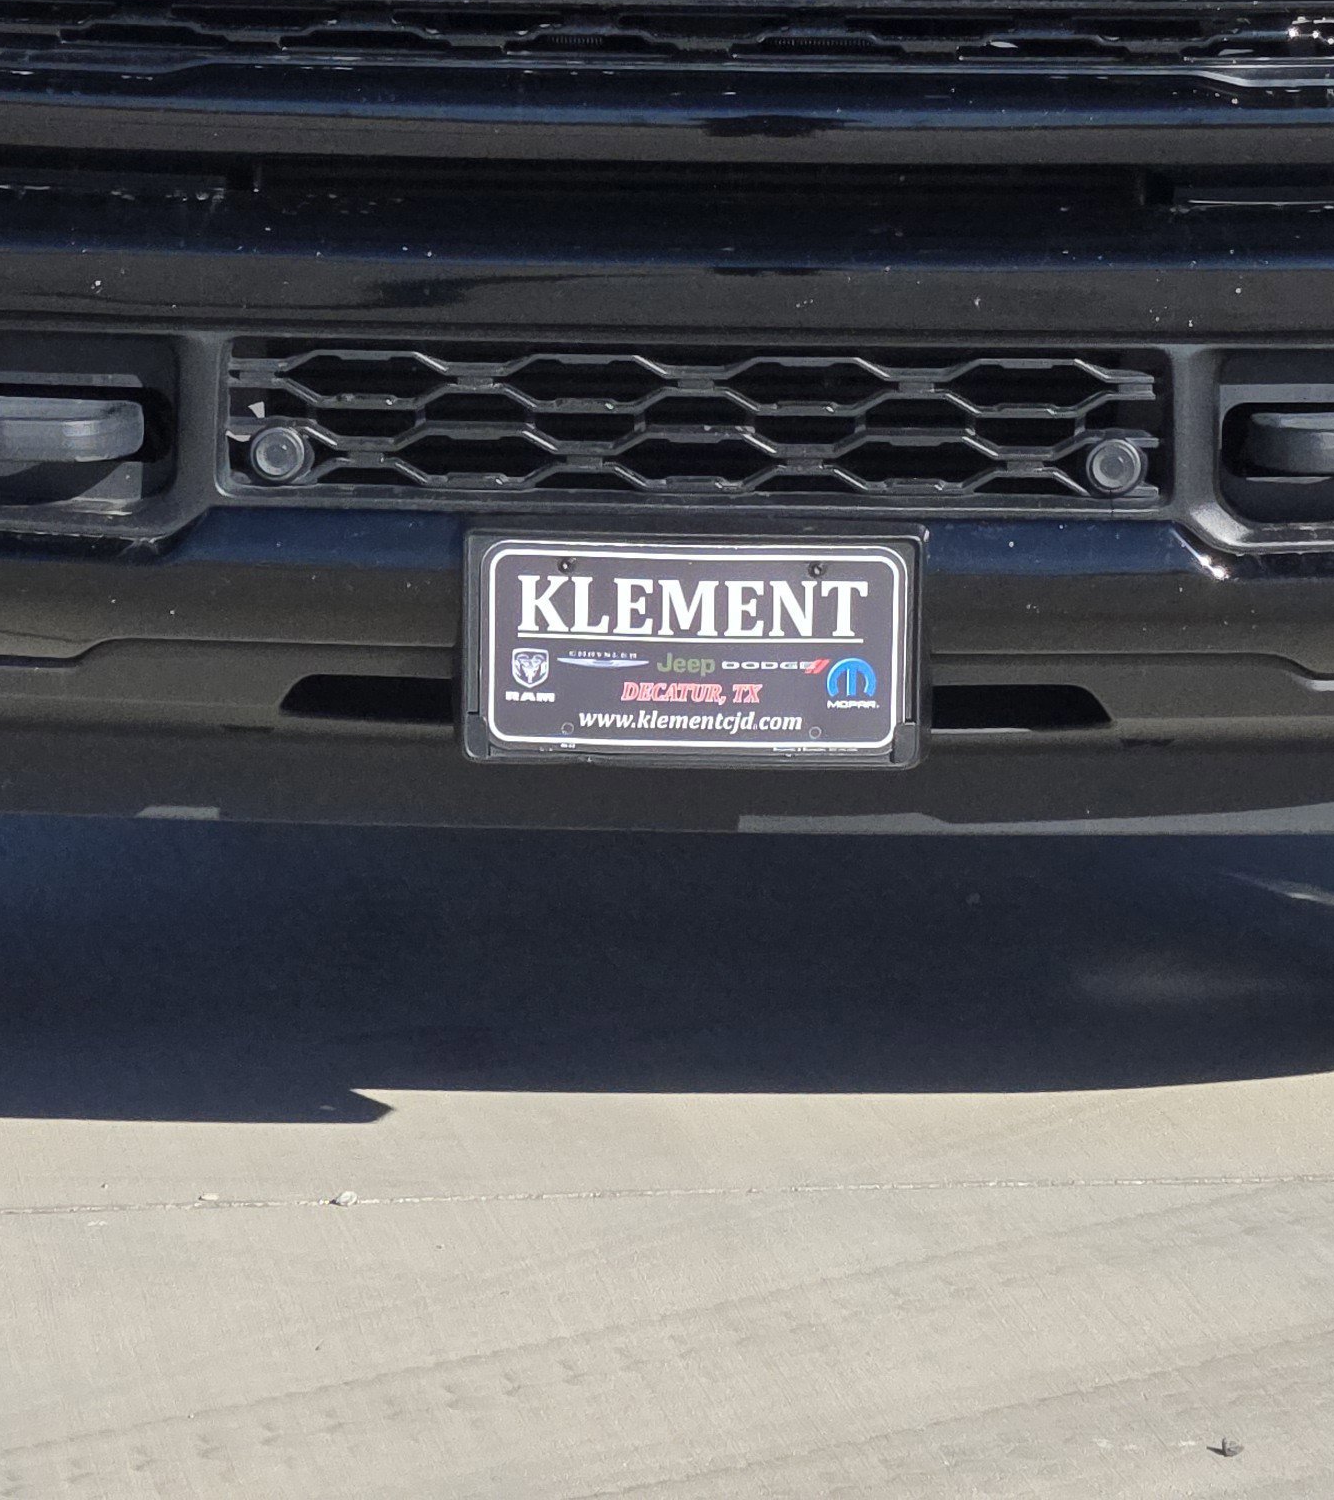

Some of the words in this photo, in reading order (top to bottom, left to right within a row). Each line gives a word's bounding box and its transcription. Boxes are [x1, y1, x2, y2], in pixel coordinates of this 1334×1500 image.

[517, 574, 869, 637] KLEMENT
[656, 652, 717, 678] Jeep
[505, 690, 556, 703] RAM
[620, 681, 727, 706] DECATUR,
[732, 683, 763, 704] TX
[578, 709, 803, 735] www.klementcjd.com
